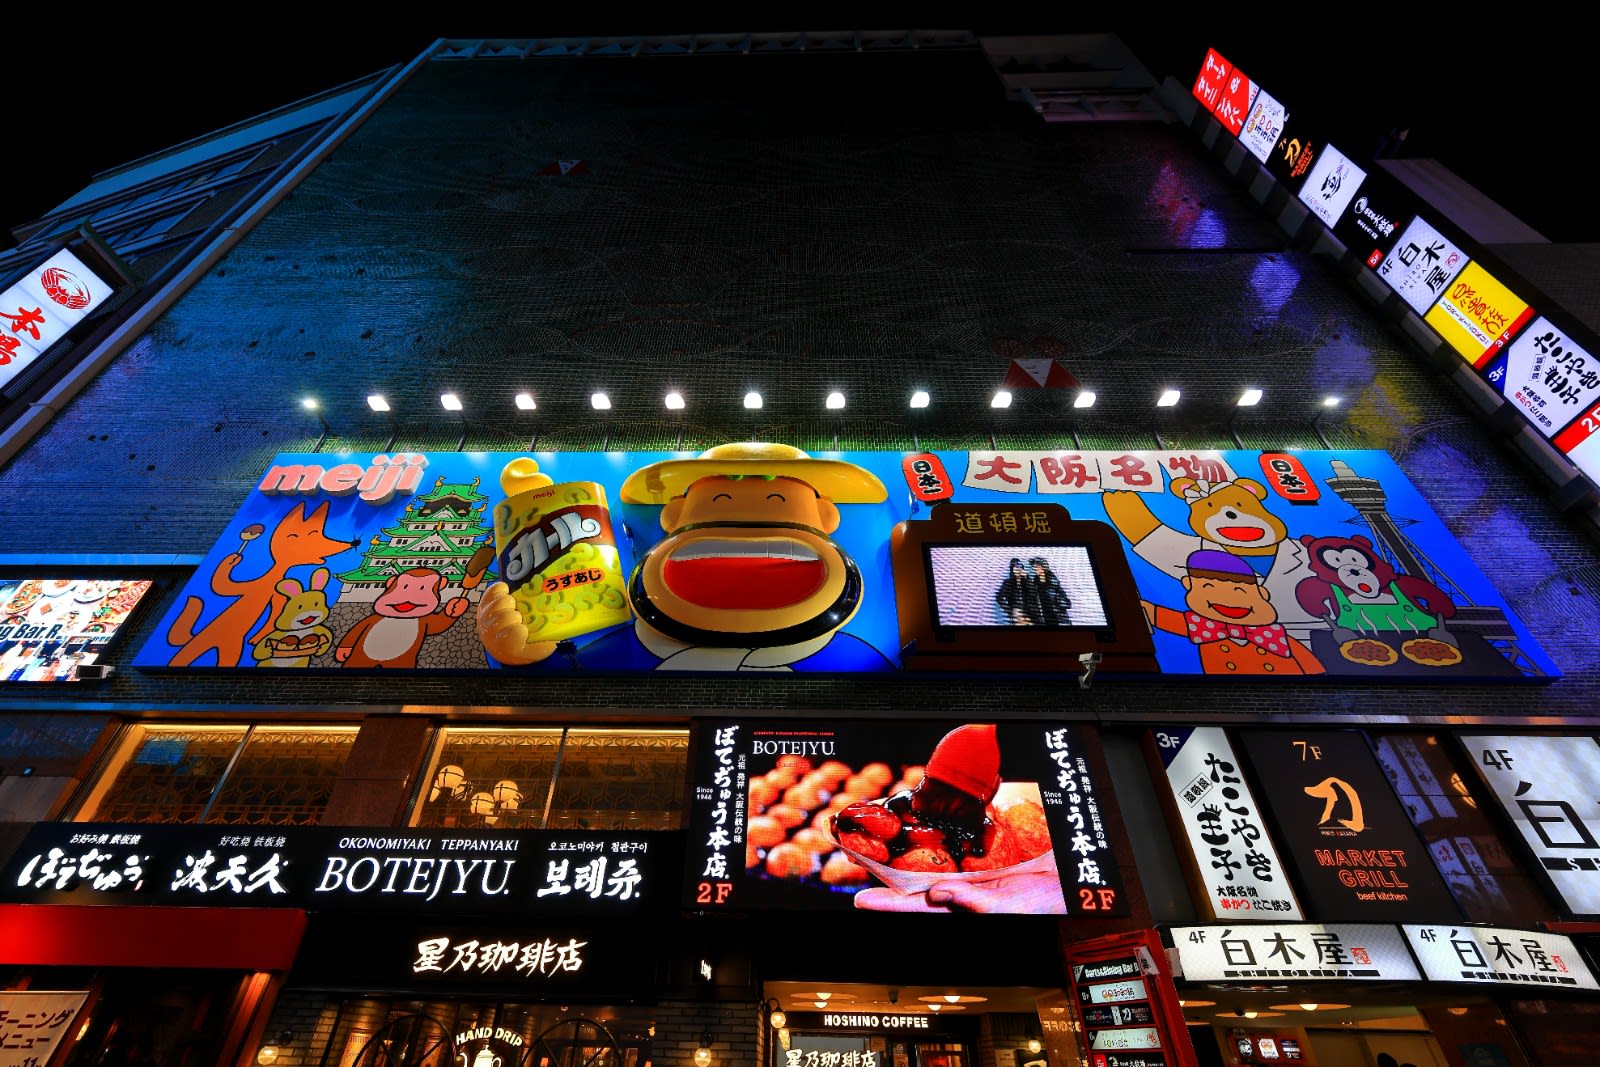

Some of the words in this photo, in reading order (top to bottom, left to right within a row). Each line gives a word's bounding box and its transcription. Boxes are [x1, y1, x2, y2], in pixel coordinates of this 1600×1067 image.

[1381, 259, 1393, 275] 4F
[1398, 240, 1451, 294] 白木屋
[1489, 366, 1505, 382] 3F
[259, 454, 429, 505] meiji
[912, 460, 942, 494] 日本一
[974, 455, 1228, 488] 大阪名物
[1270, 459, 1307, 494] 日本一
[532, 490, 555, 500] meiji
[954, 511, 1051, 534] 道頓堀
[507, 512, 601, 580] カール
[546, 569, 601, 590] うすあじ
[1156, 732, 1180, 748] 3F
[1293, 741, 1322, 761] 7F
[1482, 749, 1514, 771] 4F
[738, 754, 746, 770] 元祖
[1203, 752, 1273, 882] たこやき
[339, 837, 431, 850] OKONOMIYAKI
[441, 839, 520, 851] TEPPANYAKI
[547, 842, 604, 852] 오코노미야키
[1314, 849, 1407, 868] MARKET
[1338, 869, 1409, 888] GRILL
[696, 882, 732, 904] 2F
[1079, 888, 1116, 910] 2F
[1216, 885, 1258, 898] 大阪名物
[1356, 891, 1377, 900] beef
[1377, 891, 1408, 901] kitchen
[1188, 930, 1206, 944] 4F
[1420, 929, 1437, 942] 4F
[413, 937, 588, 978] 星乃珈琲店
[1220, 929, 1354, 966] 白木屋
[1450, 929, 1558, 973] 白木屋
[824, 1014, 879, 1027] HOSHINO
[882, 1015, 928, 1028] COFFEE
[456, 1027, 493, 1046] HAND
[494, 1027, 523, 1047] DRIP
